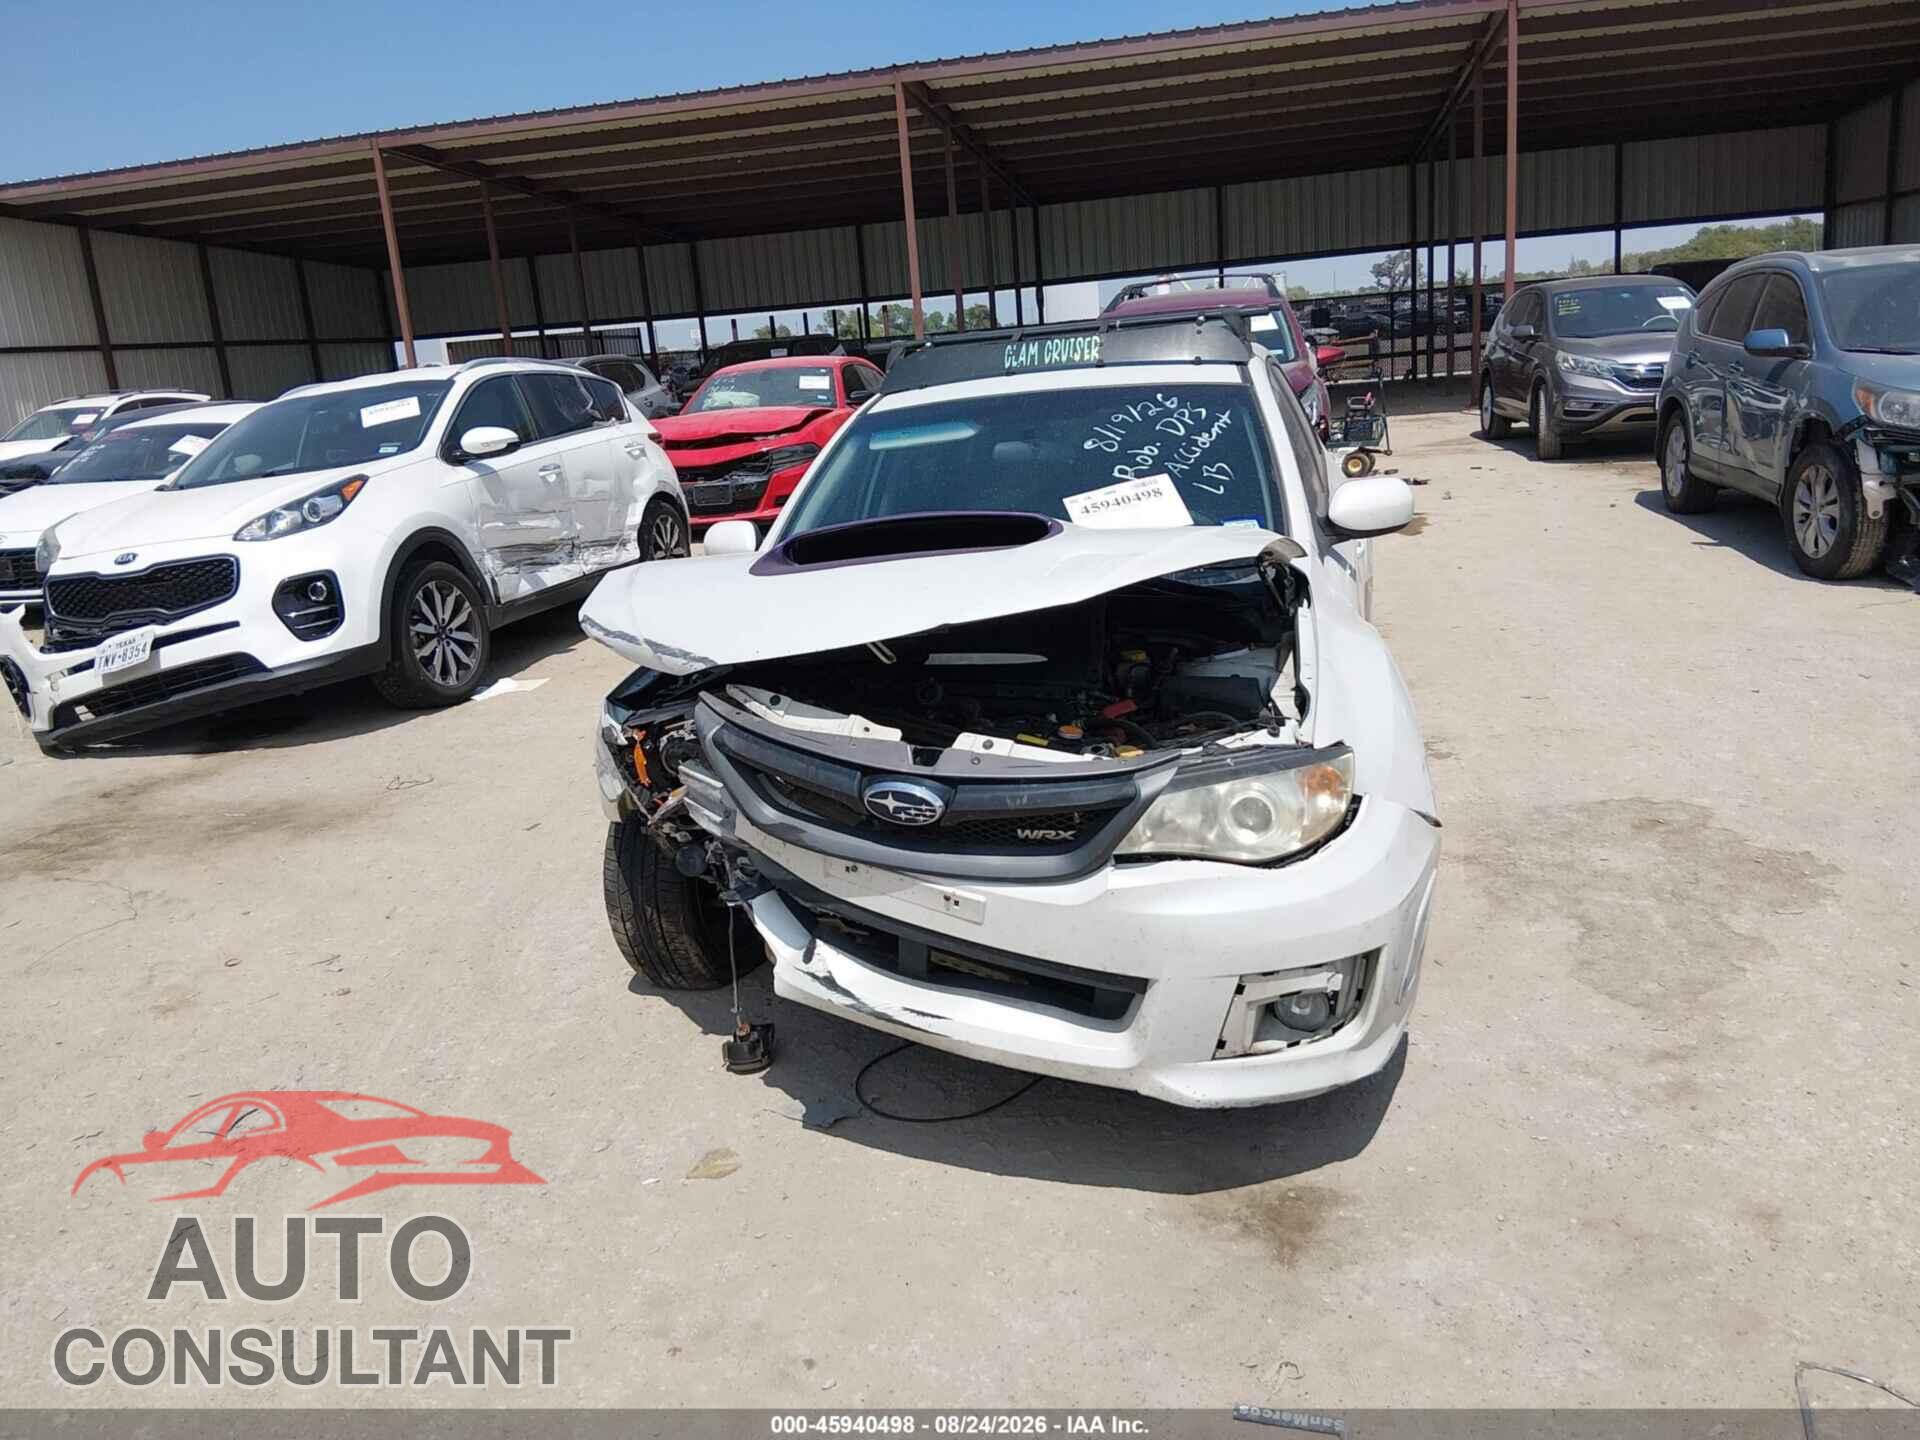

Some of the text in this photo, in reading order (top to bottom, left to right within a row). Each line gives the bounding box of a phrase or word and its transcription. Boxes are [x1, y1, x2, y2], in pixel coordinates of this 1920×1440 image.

[1044, 336, 1100, 364] CRUISER
[1155, 401, 1207, 436] DPS
[1081, 487, 1163, 516] 45940498
[1016, 828, 1077, 840] WRX
